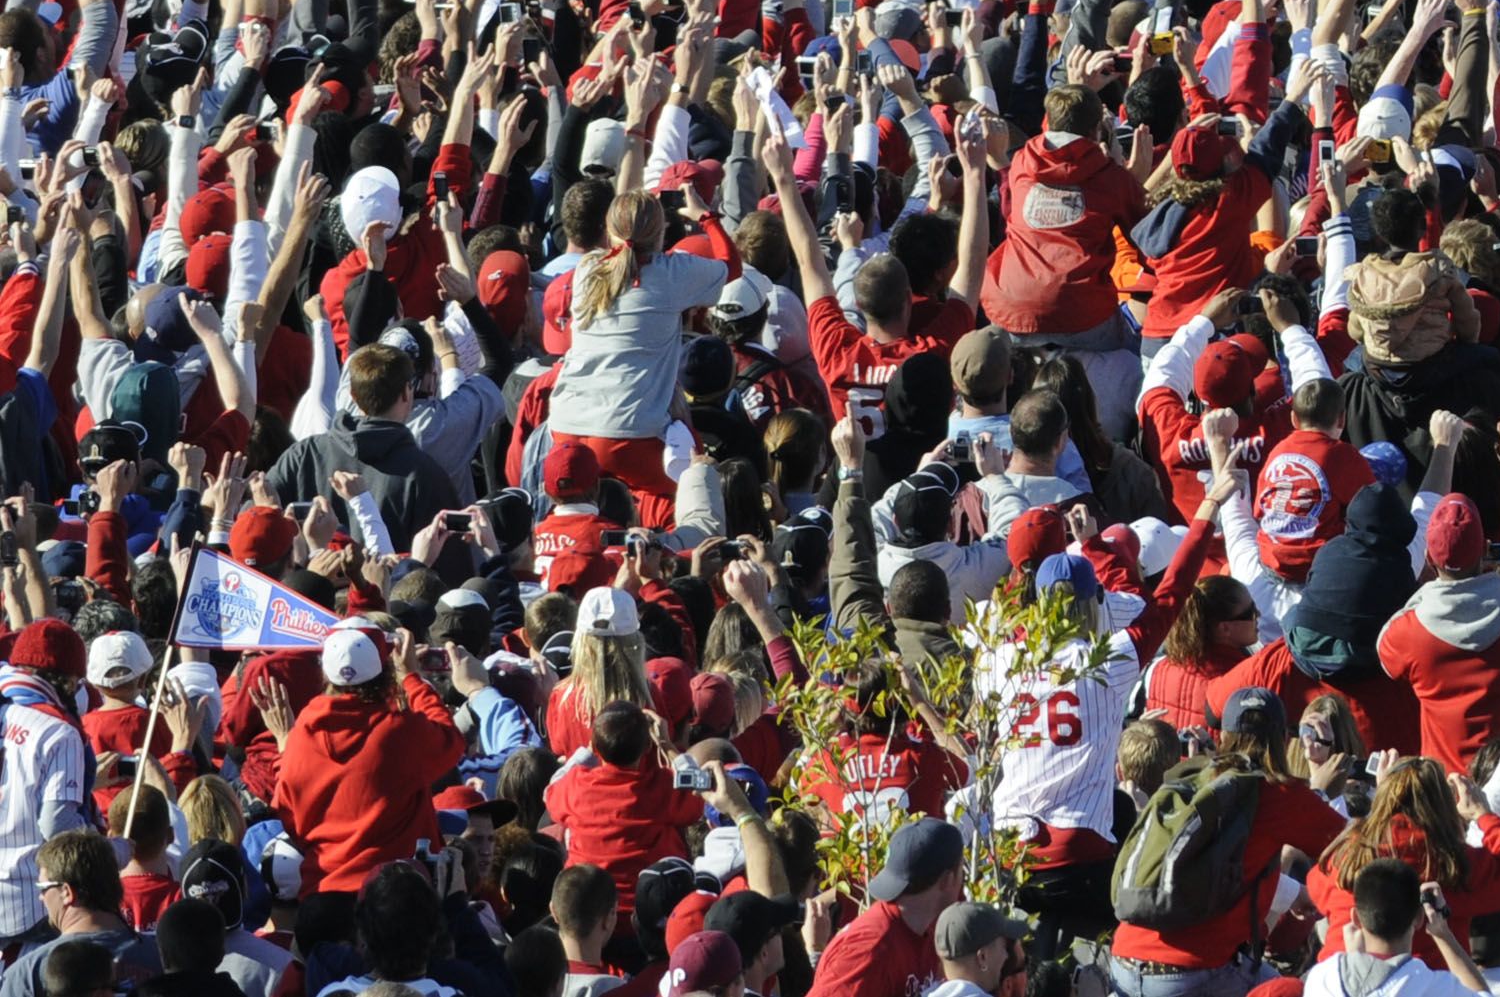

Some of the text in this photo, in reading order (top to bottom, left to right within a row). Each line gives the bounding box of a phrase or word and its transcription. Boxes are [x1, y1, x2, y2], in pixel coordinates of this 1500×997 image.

[187, 592, 263, 630] CHAMPIONS
[1009, 691, 1083, 748] 26
[845, 753, 902, 783] UTLEY
[671, 967, 687, 988] P
